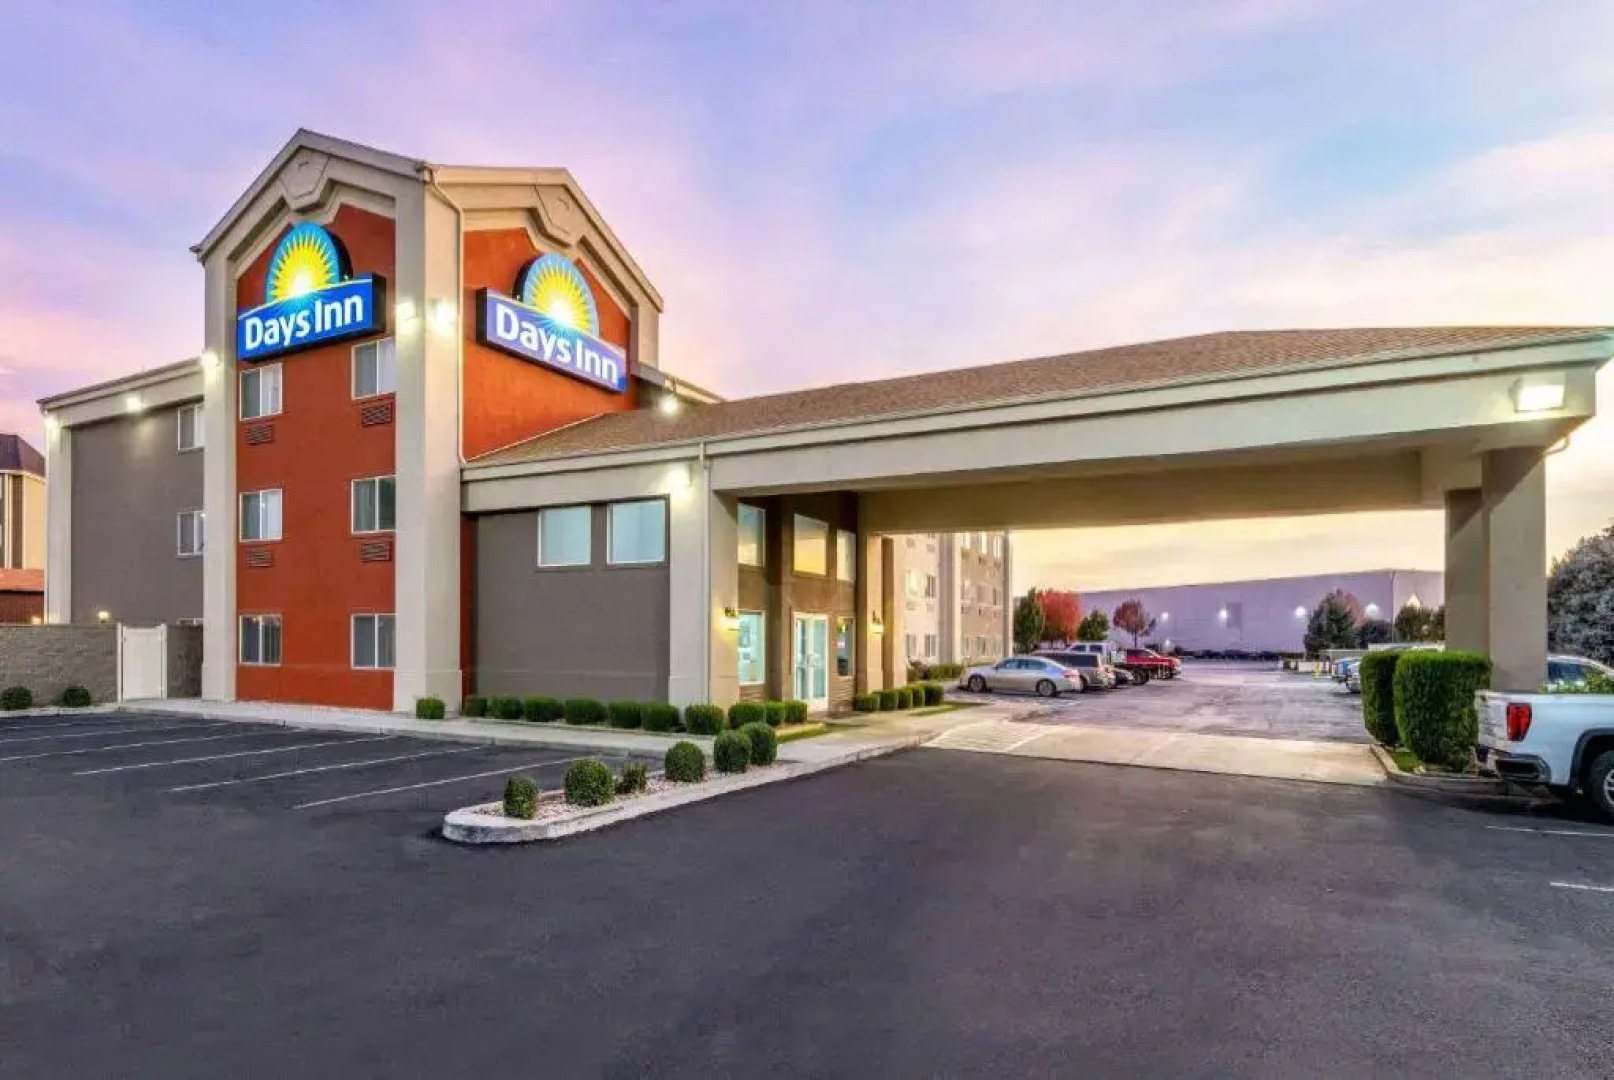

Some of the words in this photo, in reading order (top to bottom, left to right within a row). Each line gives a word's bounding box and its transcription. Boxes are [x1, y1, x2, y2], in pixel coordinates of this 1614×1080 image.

[245, 309, 311, 350] Days
[314, 294, 364, 333] Inn
[496, 303, 571, 363] Days
[576, 342, 618, 383] Inn
